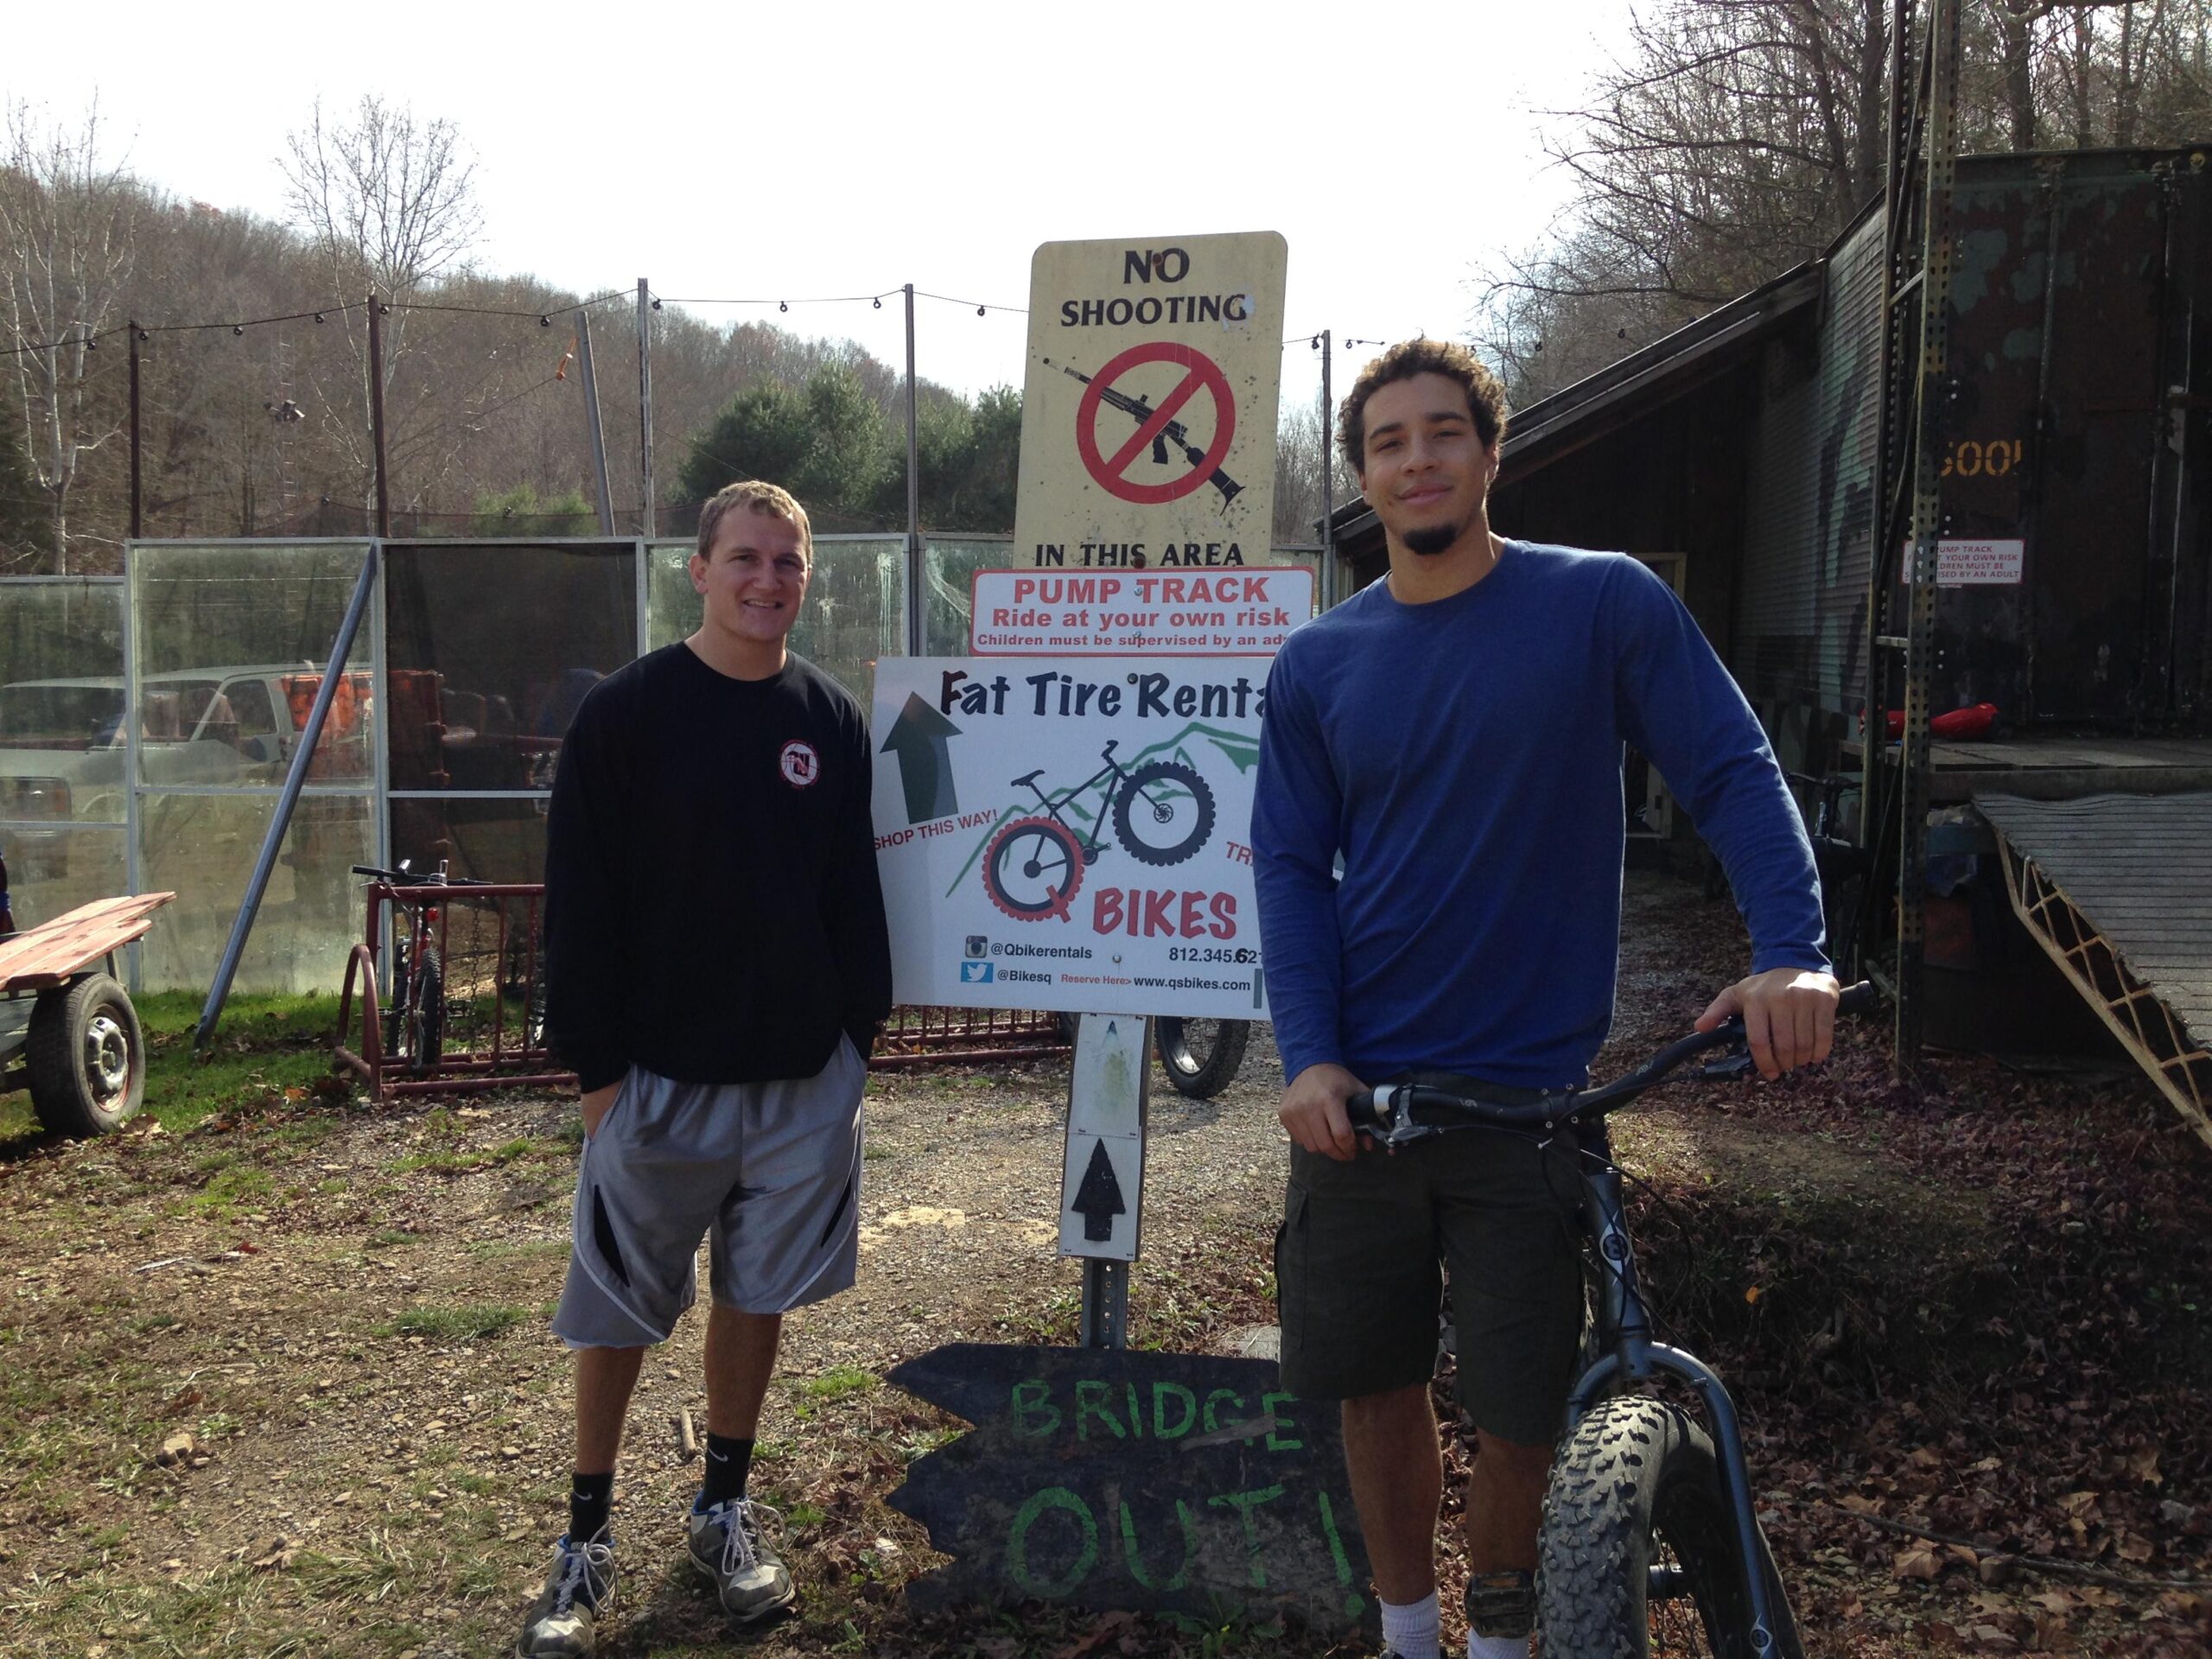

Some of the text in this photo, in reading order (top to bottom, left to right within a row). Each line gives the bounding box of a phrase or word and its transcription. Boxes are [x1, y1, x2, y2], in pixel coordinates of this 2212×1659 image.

[1123, 248, 1191, 284] NO
[1060, 294, 1247, 327] SHOOTING
[1035, 543, 1244, 567] IN THIS AREA
[1014, 577, 1269, 604] PUMP TRACK
[993, 607, 1289, 632] Ride at your own risk
[977, 634, 1287, 648] Children must be supervised by an ad
[941, 670, 1010, 715] Fat
[1027, 671, 1122, 716] Tire
[874, 809, 998, 850] SHOP THIS WAY!
[1092, 887, 1237, 940] BIKES
[991, 943, 1092, 960] @Qbikerentals
[997, 969, 1052, 985] @Bikesq
[1061, 974, 1100, 984] Reserve
[1134, 976, 1251, 991] www.qsbikes.com
[1011, 1380, 1303, 1451] BRIDGE
[1007, 1484, 1365, 1618] OUT!
